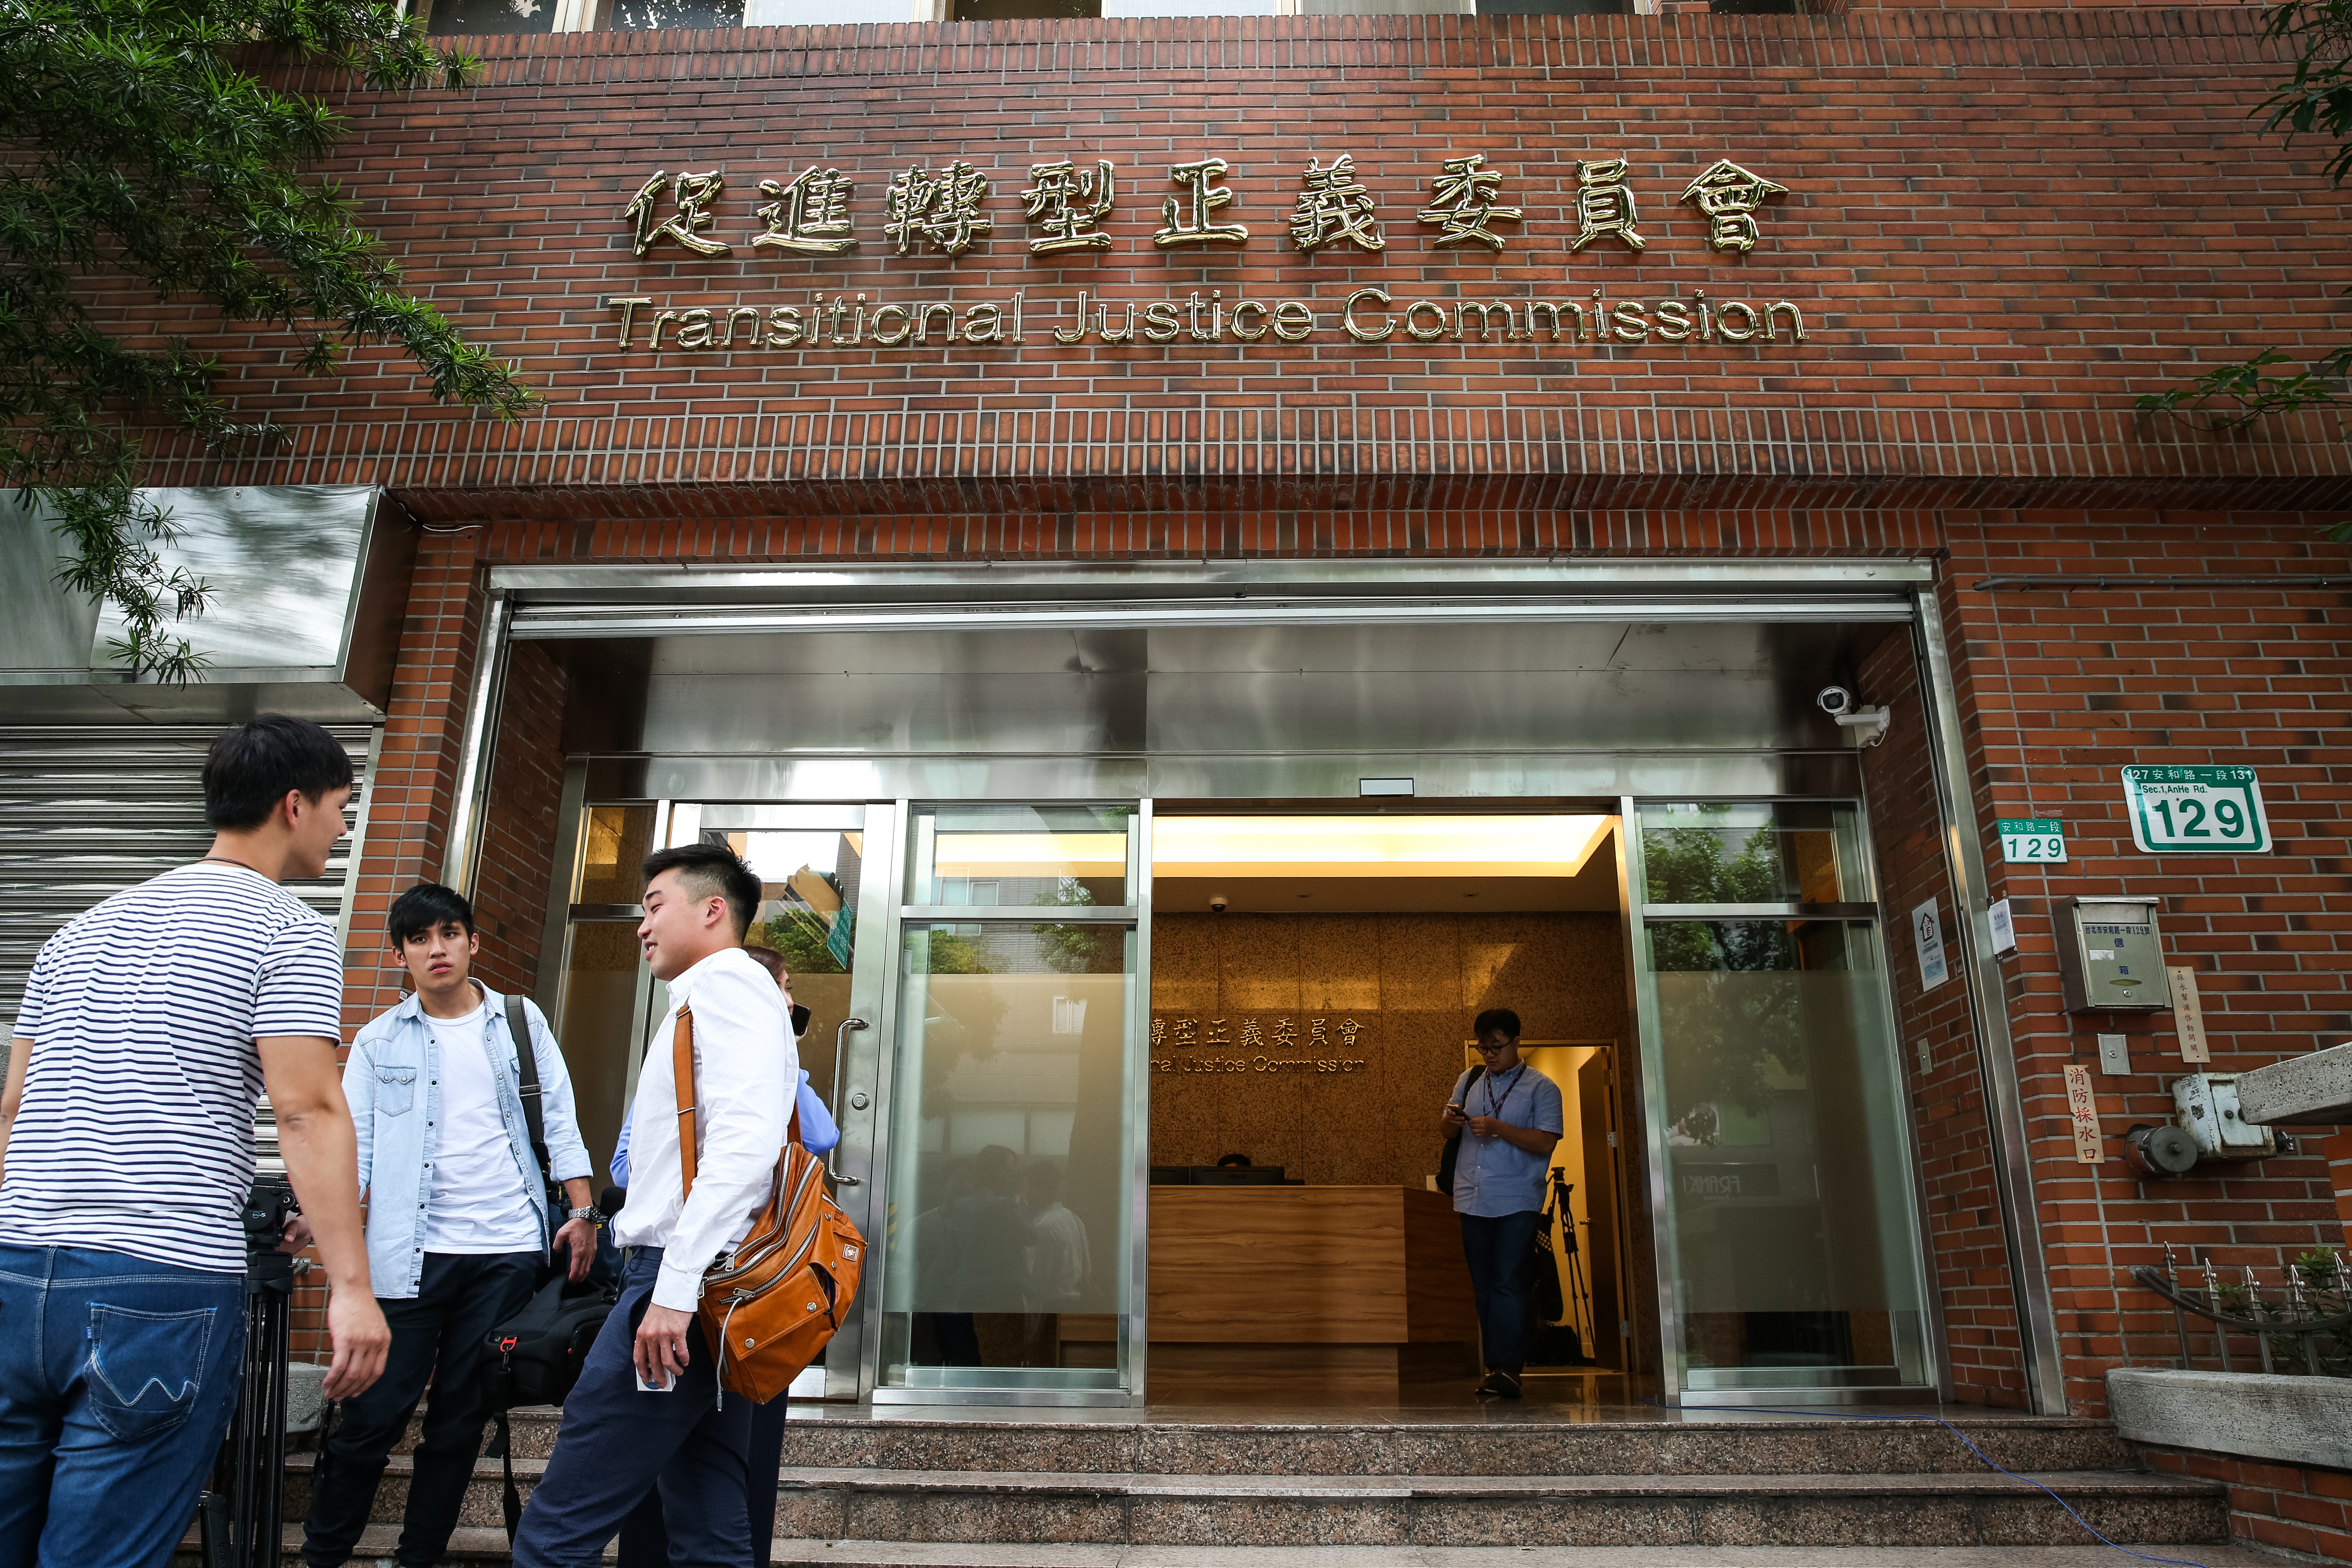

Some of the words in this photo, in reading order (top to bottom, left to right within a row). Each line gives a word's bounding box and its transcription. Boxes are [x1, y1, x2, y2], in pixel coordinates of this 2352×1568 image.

[624, 153, 1789, 258] 促進轉型正義委員會
[606, 291, 1025, 350] Transitional
[1054, 288, 1313, 347] Justice
[1341, 287, 1810, 344] Commission
[2127, 770, 2149, 780] 127
[2152, 769, 2227, 780] 安和路一段
[2230, 770, 2252, 780] 131
[2143, 785, 2189, 794] Sec.1,AnHe
[2002, 822, 2060, 832] 安和路一段
[2152, 799, 2245, 838] 129
[2008, 838, 2061, 858] 129
[2069, 1068, 2097, 1159] 消防採水口
